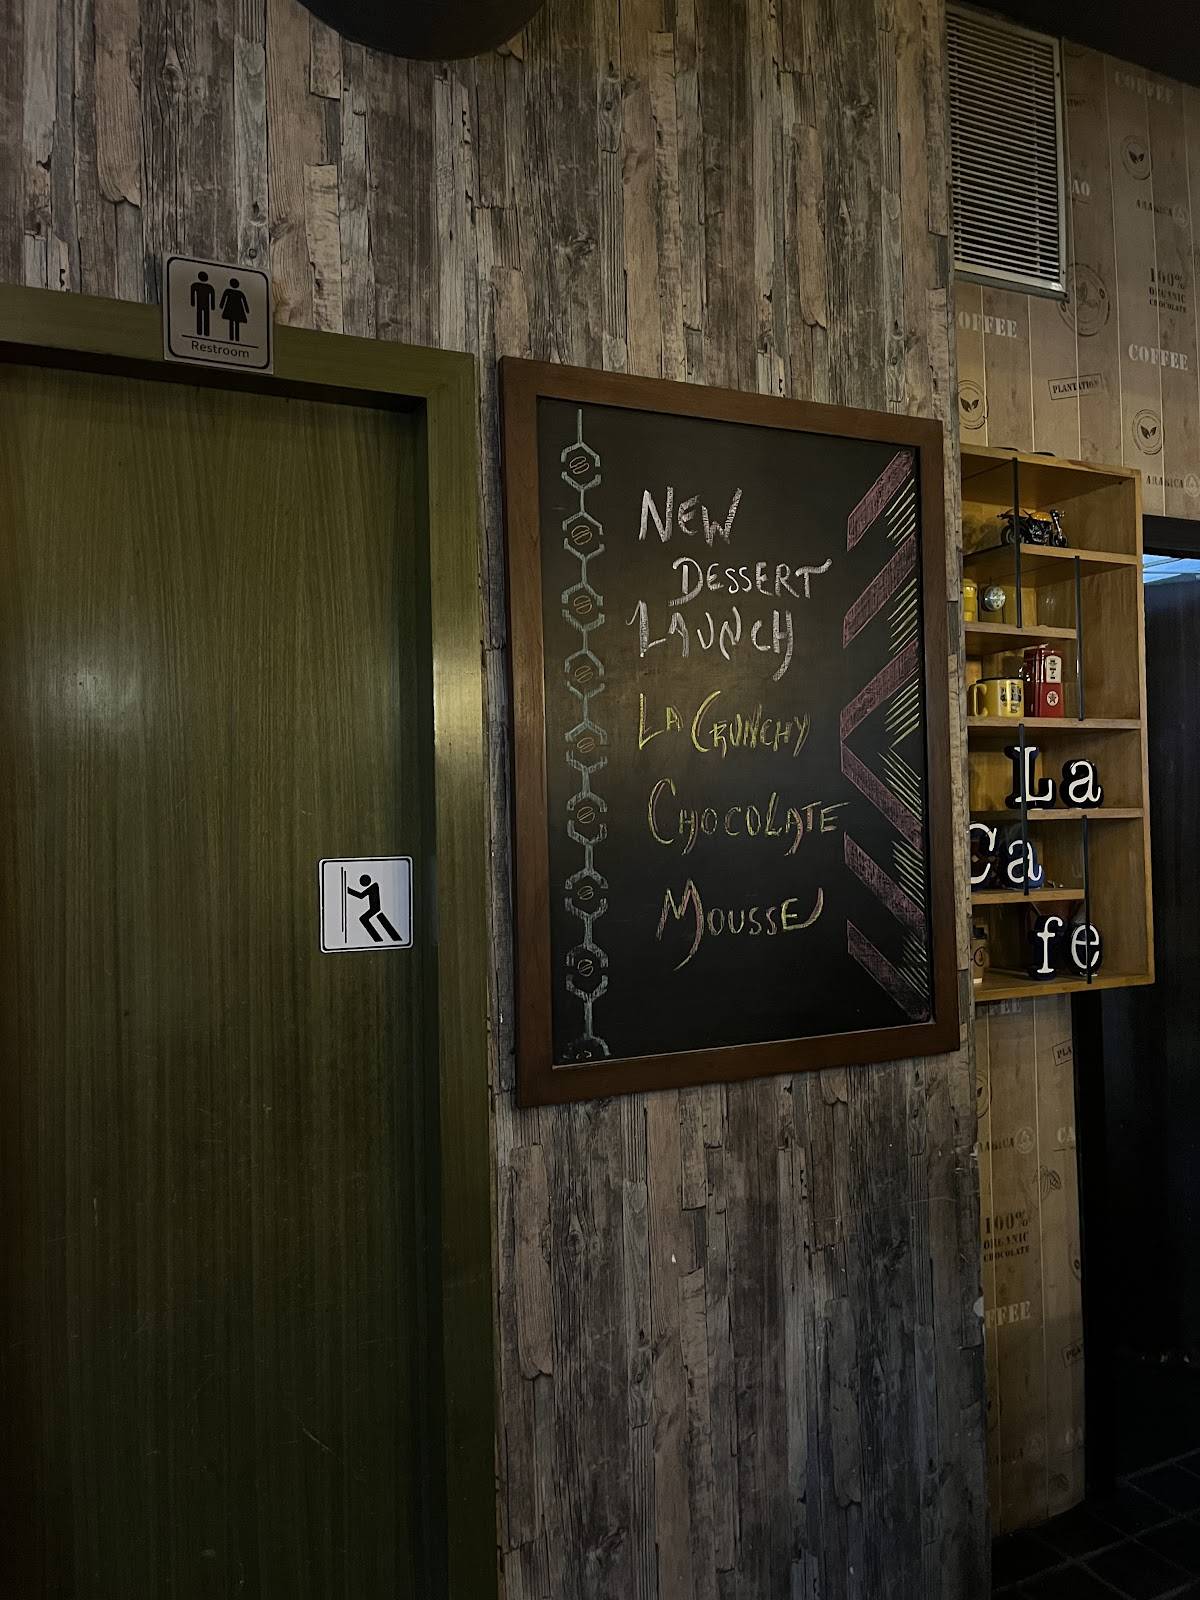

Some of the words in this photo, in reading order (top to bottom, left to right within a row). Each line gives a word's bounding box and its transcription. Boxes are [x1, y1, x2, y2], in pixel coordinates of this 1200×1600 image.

[191, 340, 250, 358] Restroom
[958, 311, 1017, 338] OFFEE
[1128, 343, 1188, 371] COFFEE
[638, 486, 743, 547] NEW
[668, 556, 832, 607] DESSERT
[626, 600, 793, 682] LAUNCH
[638, 693, 684, 750] LA
[691, 690, 811, 758] CRUNCHY
[1013, 746, 1102, 804] La
[648, 778, 850, 856] CHOCOLATE
[656, 878, 824, 971] MOUSSE
[1036, 916, 1100, 973] fe
